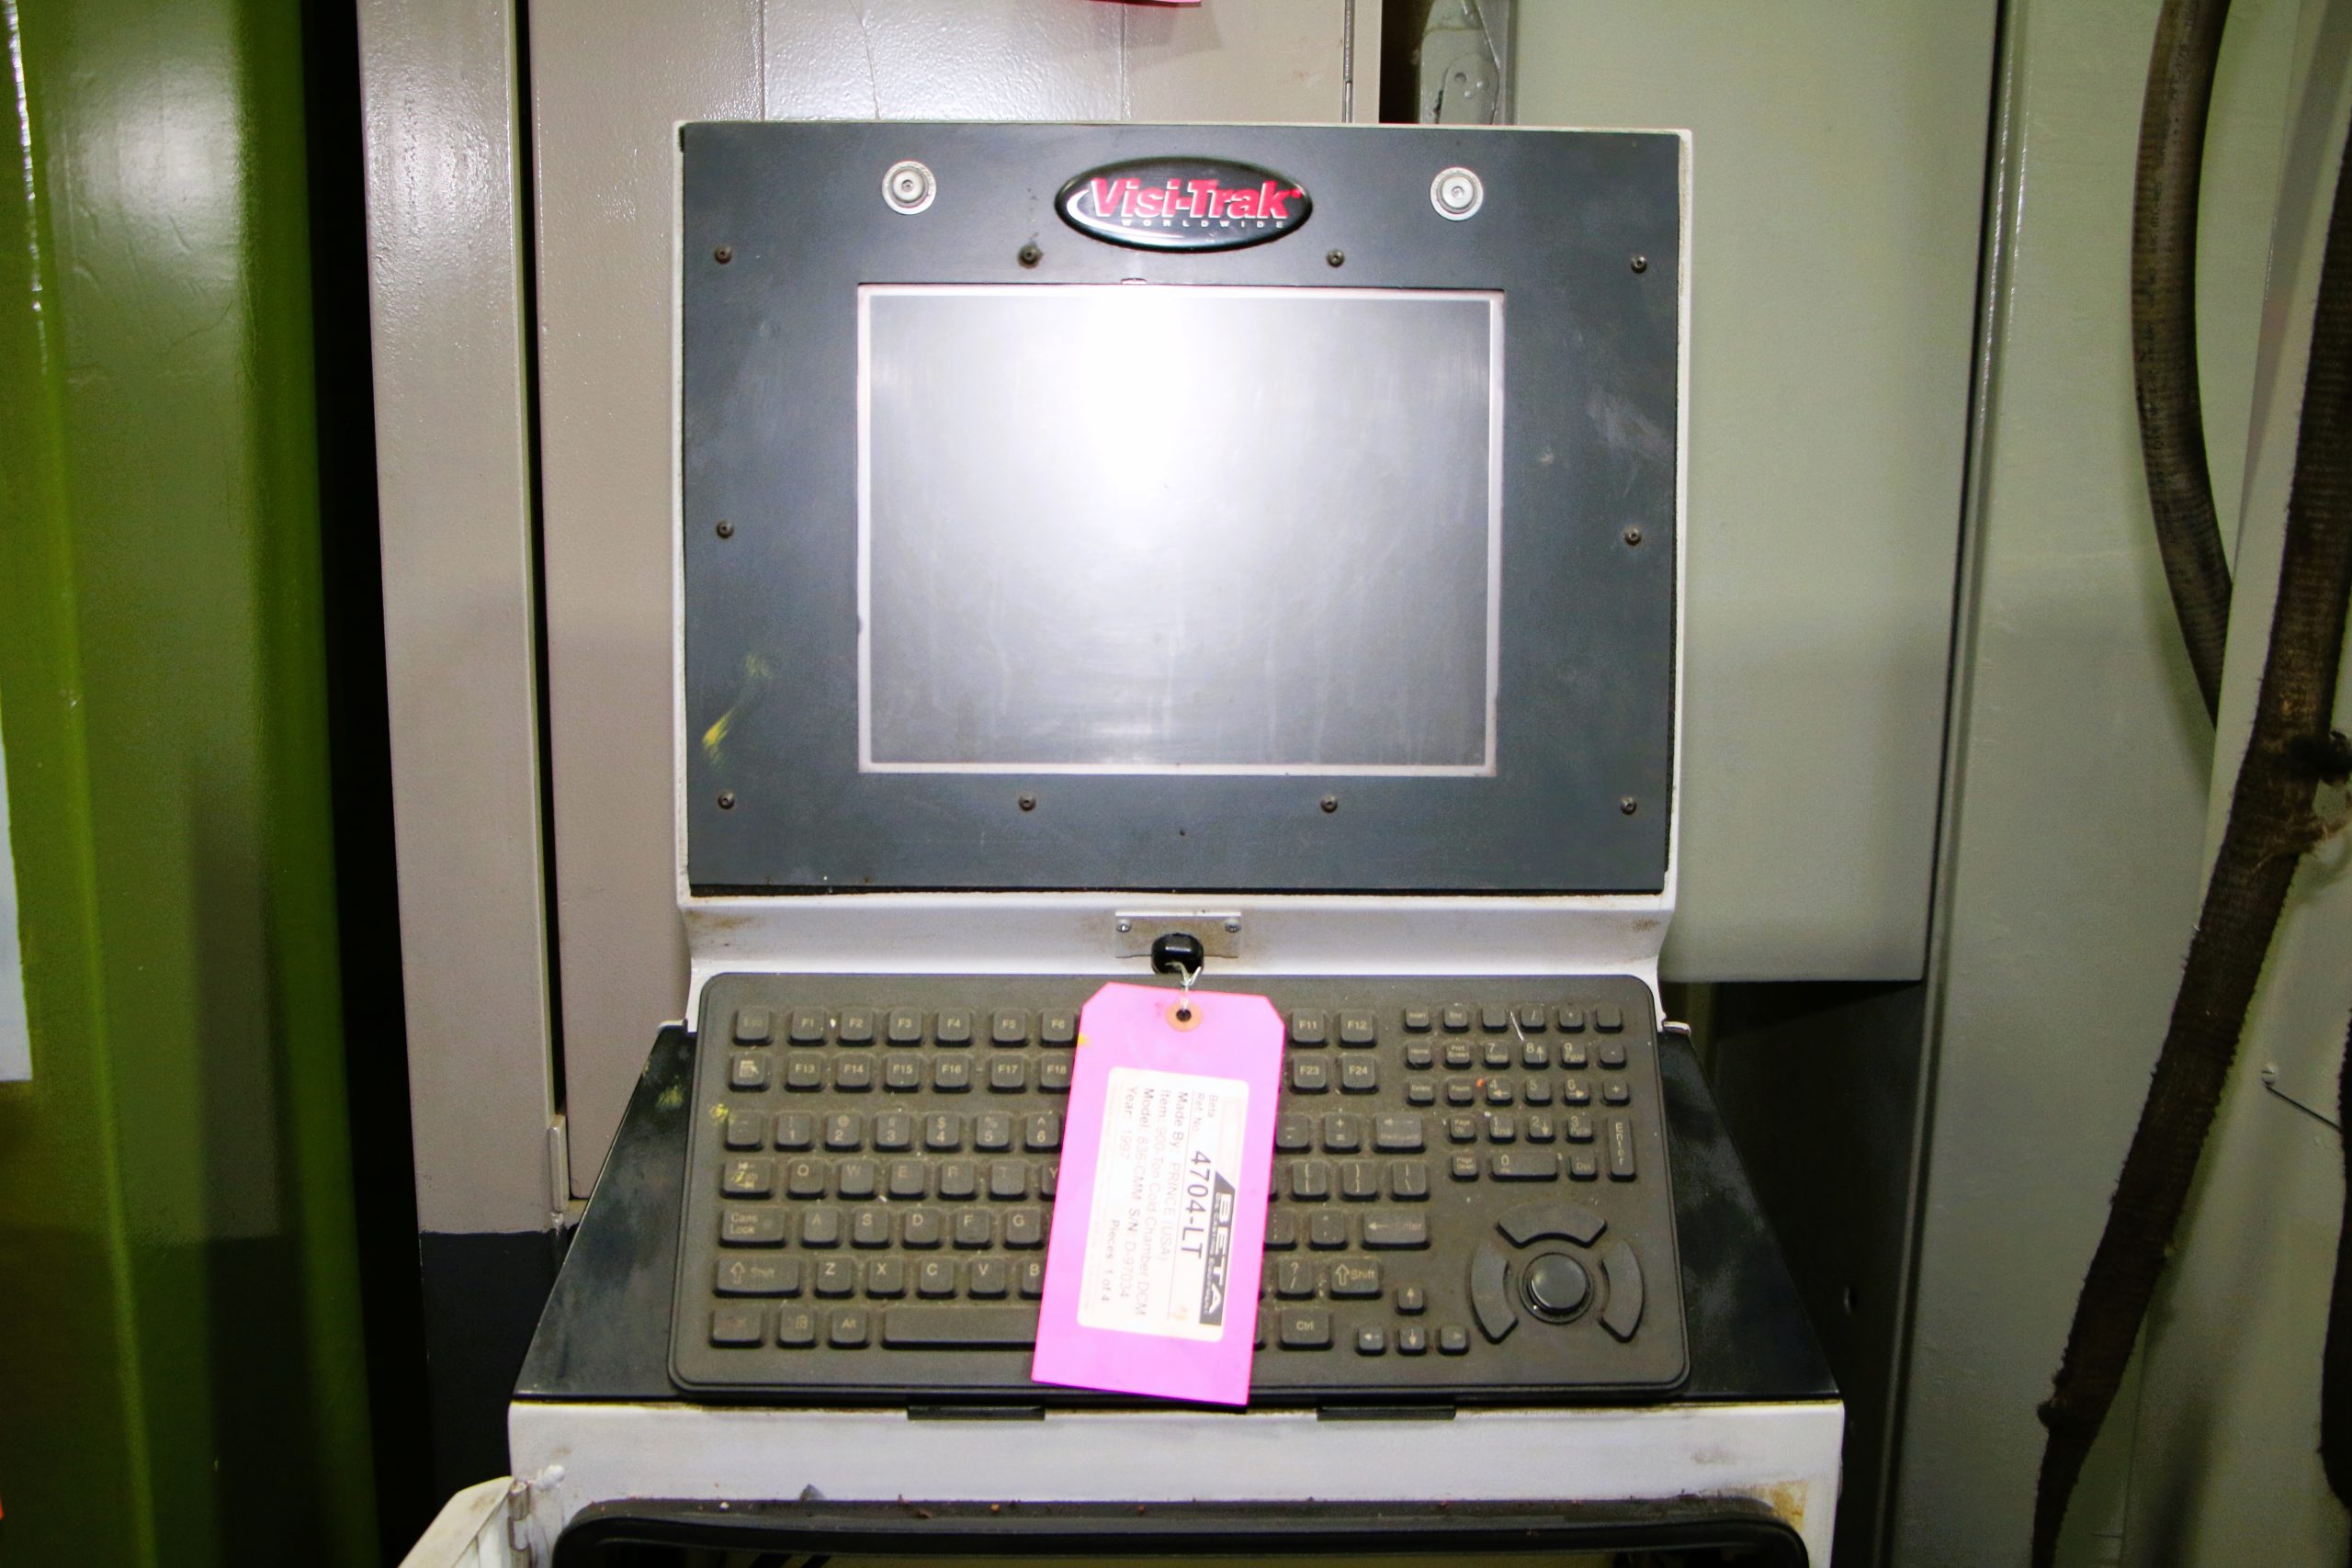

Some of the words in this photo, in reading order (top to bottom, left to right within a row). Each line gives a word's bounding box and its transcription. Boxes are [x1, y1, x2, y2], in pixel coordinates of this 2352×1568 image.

[1089, 177, 1289, 220] Visi-Trak
[1121, 219, 1285, 229] WORLDWIDE
[801, 1018, 814, 1028] F1
[849, 1018, 864, 1028] F2
[898, 1019, 912, 1029] F3
[947, 1019, 961, 1028] F4
[1001, 1020, 1016, 1029] F5
[1051, 1020, 1065, 1029] F6
[1298, 1021, 1317, 1030] F11
[1347, 1021, 1368, 1030] F12
[1487, 1043, 1496, 1054] 7
[1526, 1042, 1534, 1054] 8
[1564, 1042, 1573, 1054] 9
[795, 1064, 816, 1074] F13
[843, 1064, 865, 1074] F14
[892, 1065, 913, 1075] F15
[941, 1064, 962, 1075] F16
[998, 1065, 1018, 1075] F17
[1046, 1065, 1067, 1075] F18
[1299, 1066, 1320, 1076] F23
[1349, 1066, 1368, 1076] F24
[1489, 1078, 1498, 1089] 4
[1529, 1078, 1537, 1091] 5
[1566, 1078, 1576, 1091] 6
[1140, 1087, 1155, 1133] Model:
[1175, 1091, 1189, 1127] Made
[1208, 1094, 1218, 1118] Beta
[1532, 1115, 1540, 1128] 2
[833, 1129, 844, 1142] 2
[886, 1129, 897, 1142] 3
[936, 1130, 945, 1143] 4
[1119, 1129, 1133, 1161] 1997
[1152, 1126, 1168, 1179] 900-Ton
[1500, 1154, 1510, 1167] 0
[898, 1165, 910, 1178] E
[1164, 1162, 1181, 1217] PRINCE
[1148, 1182, 1161, 1213] Cold
[1181, 1150, 1212, 1259] 4704-LT
[811, 1213, 822, 1225] A
[862, 1213, 873, 1226] S
[911, 1213, 923, 1225] D
[963, 1214, 974, 1226] F
[1012, 1214, 1025, 1227] G
[1140, 1216, 1157, 1278] Chamber
[1158, 1220, 1173, 1262] (USA)
[1209, 1193, 1231, 1314] BETA
[825, 1262, 837, 1276] Z
[876, 1263, 888, 1275] X
[926, 1262, 938, 1276] C
[978, 1263, 989, 1276] V
[1029, 1263, 1040, 1276] B
[1350, 1269, 1375, 1280] Shift
[1102, 1278, 1113, 1292] of
[1102, 1294, 1111, 1303] 4
[1136, 1280, 1149, 1316] DCM
[1295, 1321, 1315, 1331] Ctrl
